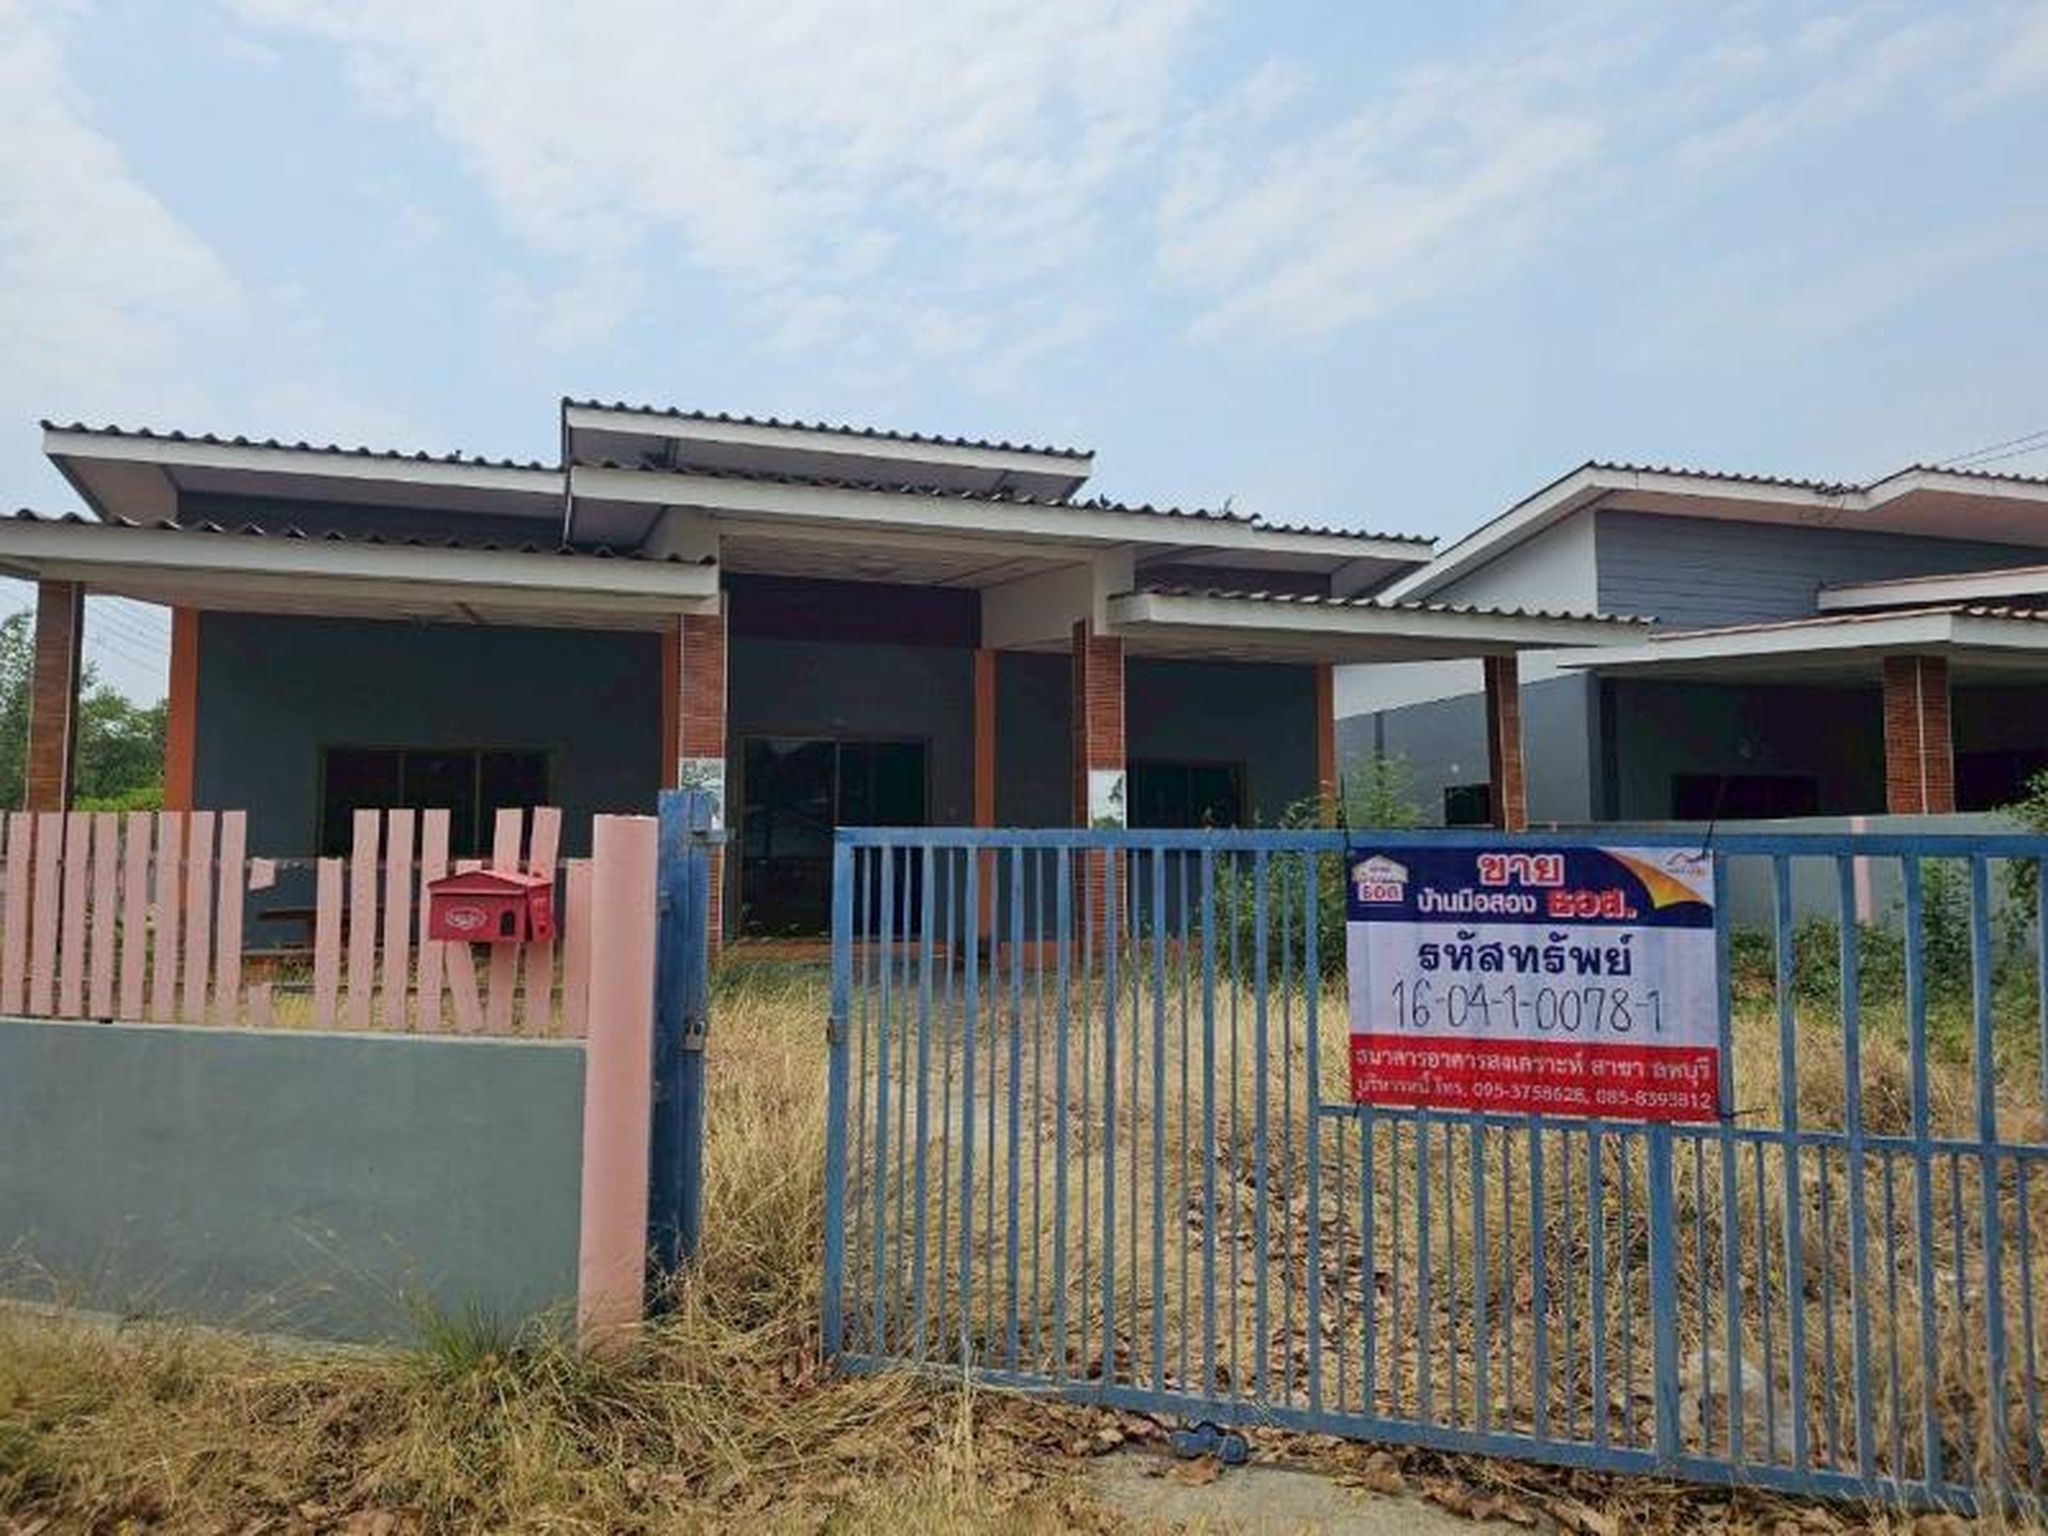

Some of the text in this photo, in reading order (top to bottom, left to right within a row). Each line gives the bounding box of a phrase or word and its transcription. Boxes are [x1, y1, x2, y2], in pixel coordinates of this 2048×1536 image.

[1477, 852, 1564, 885] ขาย
[1417, 887, 1536, 913] บ้านมือสอง
[1418, 930, 1633, 976] รหัสทรัพย์
[1392, 977, 1664, 1034] 16-04-1-0078-1
